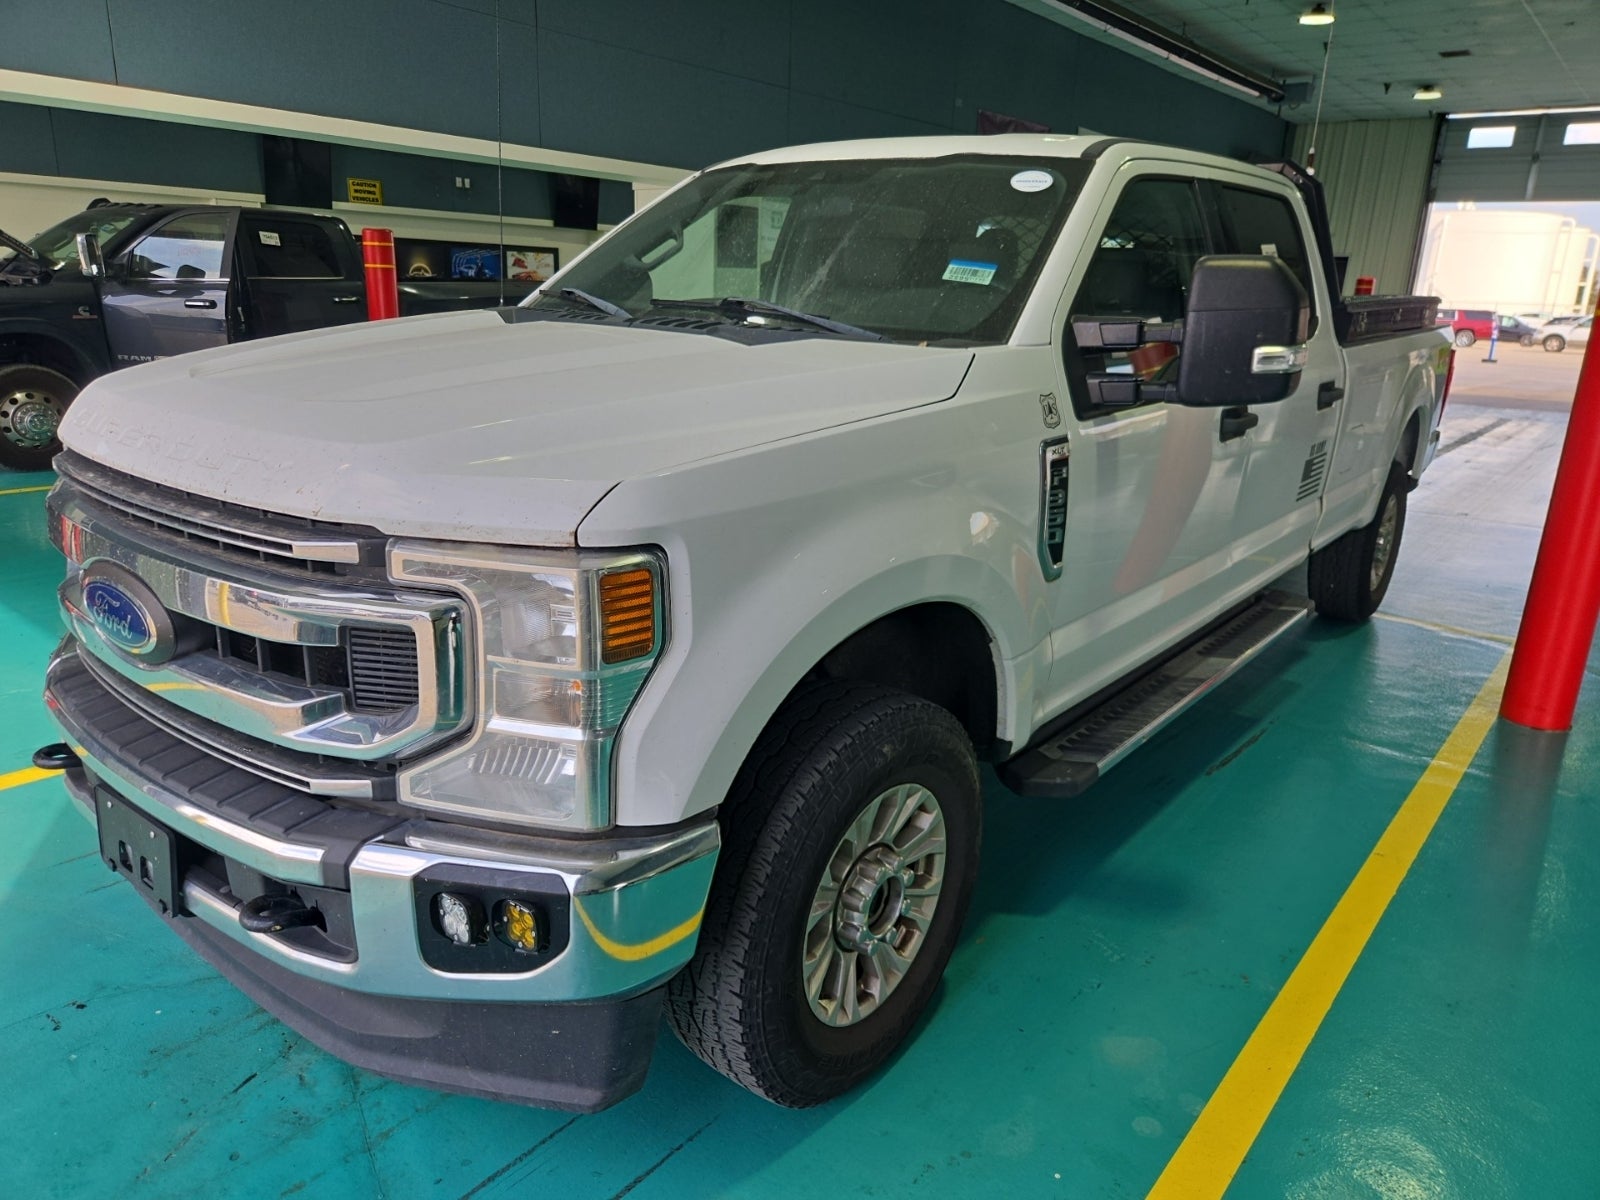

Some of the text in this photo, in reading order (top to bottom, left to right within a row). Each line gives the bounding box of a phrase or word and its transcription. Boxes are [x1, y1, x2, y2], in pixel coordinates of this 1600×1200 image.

[117, 354, 151, 362] RAM
[1051, 446, 1065, 455] XLT
[93, 591, 132, 639] Ford
